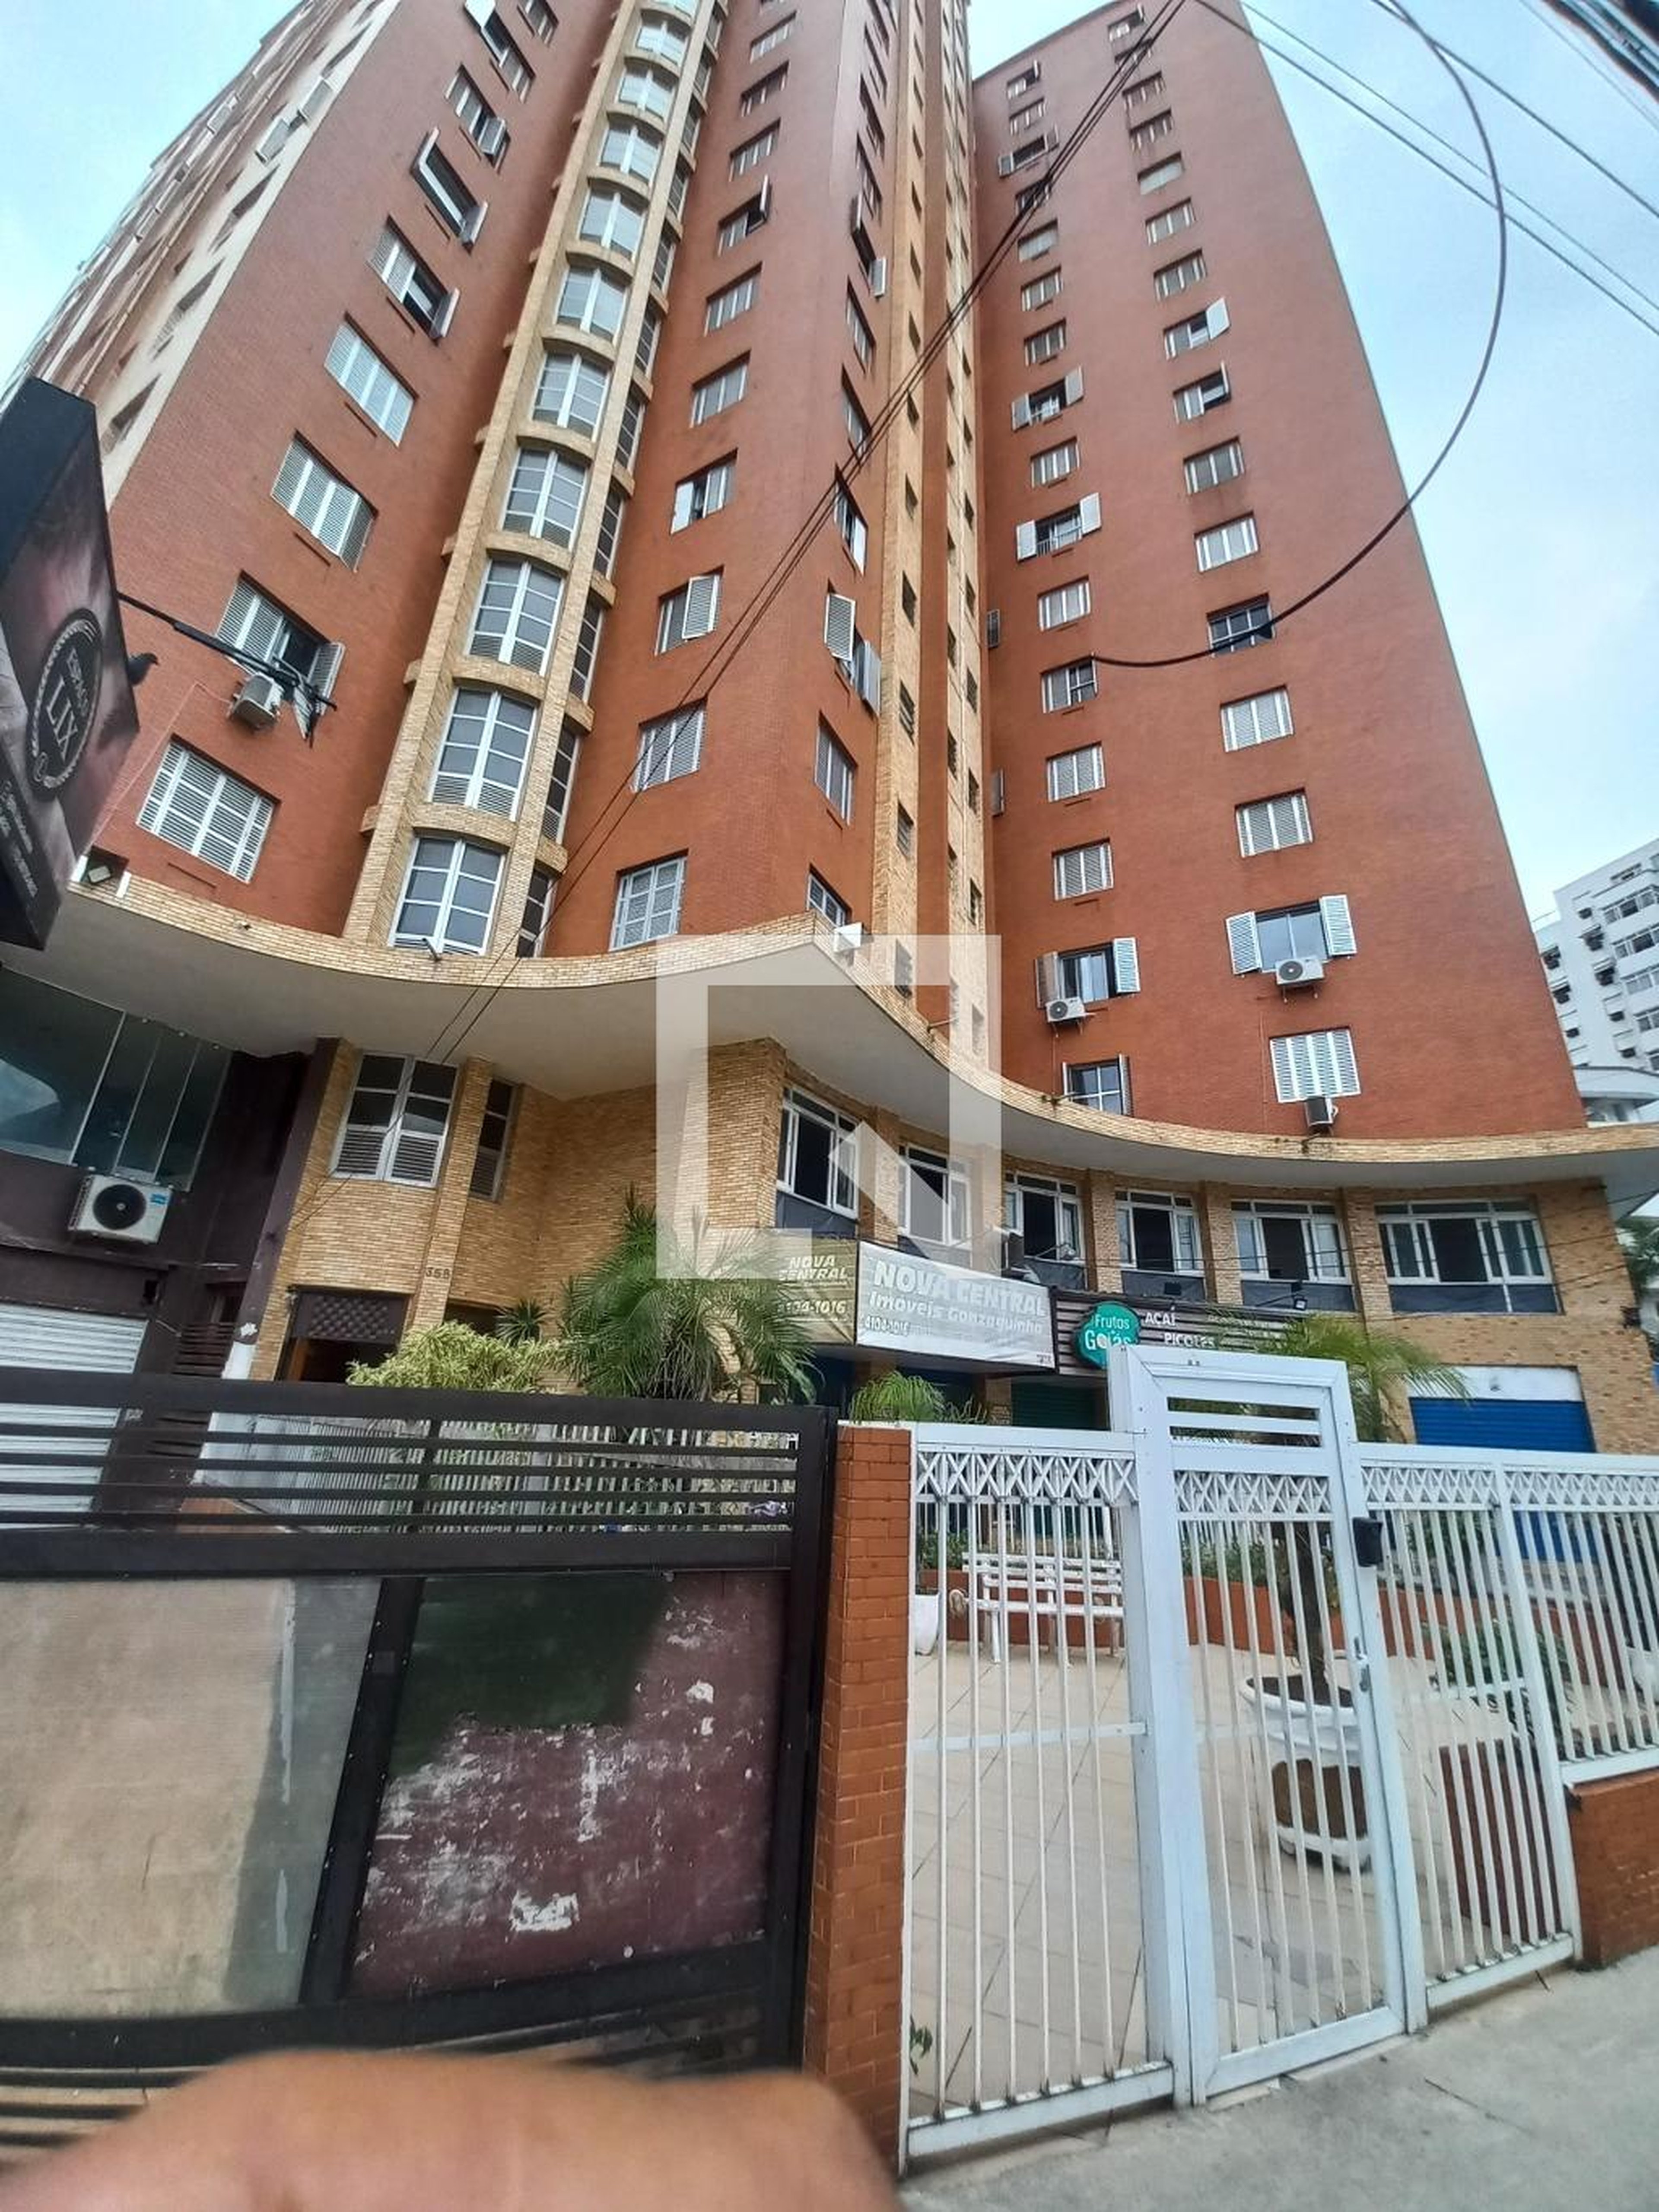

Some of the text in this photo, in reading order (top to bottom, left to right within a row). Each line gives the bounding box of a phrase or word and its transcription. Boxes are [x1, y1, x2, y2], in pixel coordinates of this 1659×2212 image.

[46, 675, 78, 765] LIX
[789, 1255, 835, 1269] NOVA
[779, 1267, 848, 1281] CENTRAL
[874, 1260, 1046, 1317] NOVA CENTRAL
[1095, 1314, 1130, 1330] Frutos
